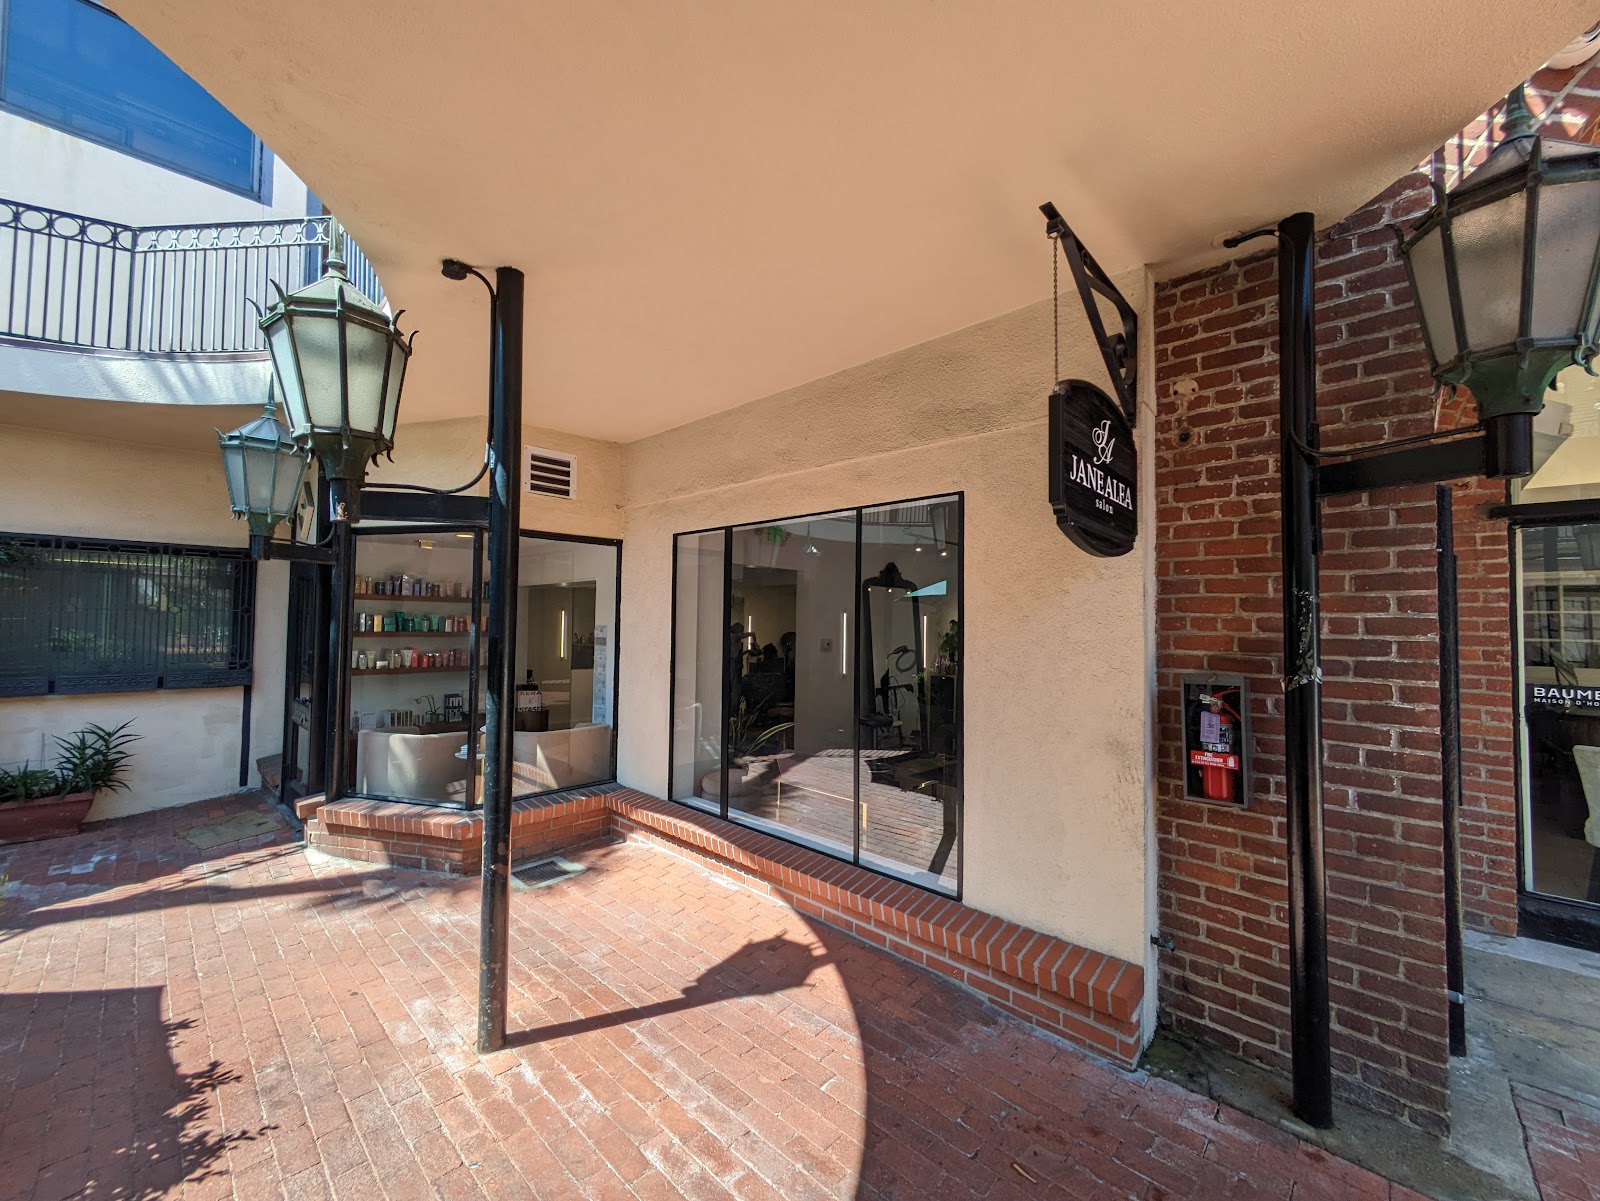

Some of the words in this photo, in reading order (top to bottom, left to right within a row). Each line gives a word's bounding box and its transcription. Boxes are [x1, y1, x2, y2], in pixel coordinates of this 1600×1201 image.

[1070, 454, 1133, 511] JANEALEA
[1095, 499, 1114, 515] salon
[1534, 698, 1570, 706] MAISON
